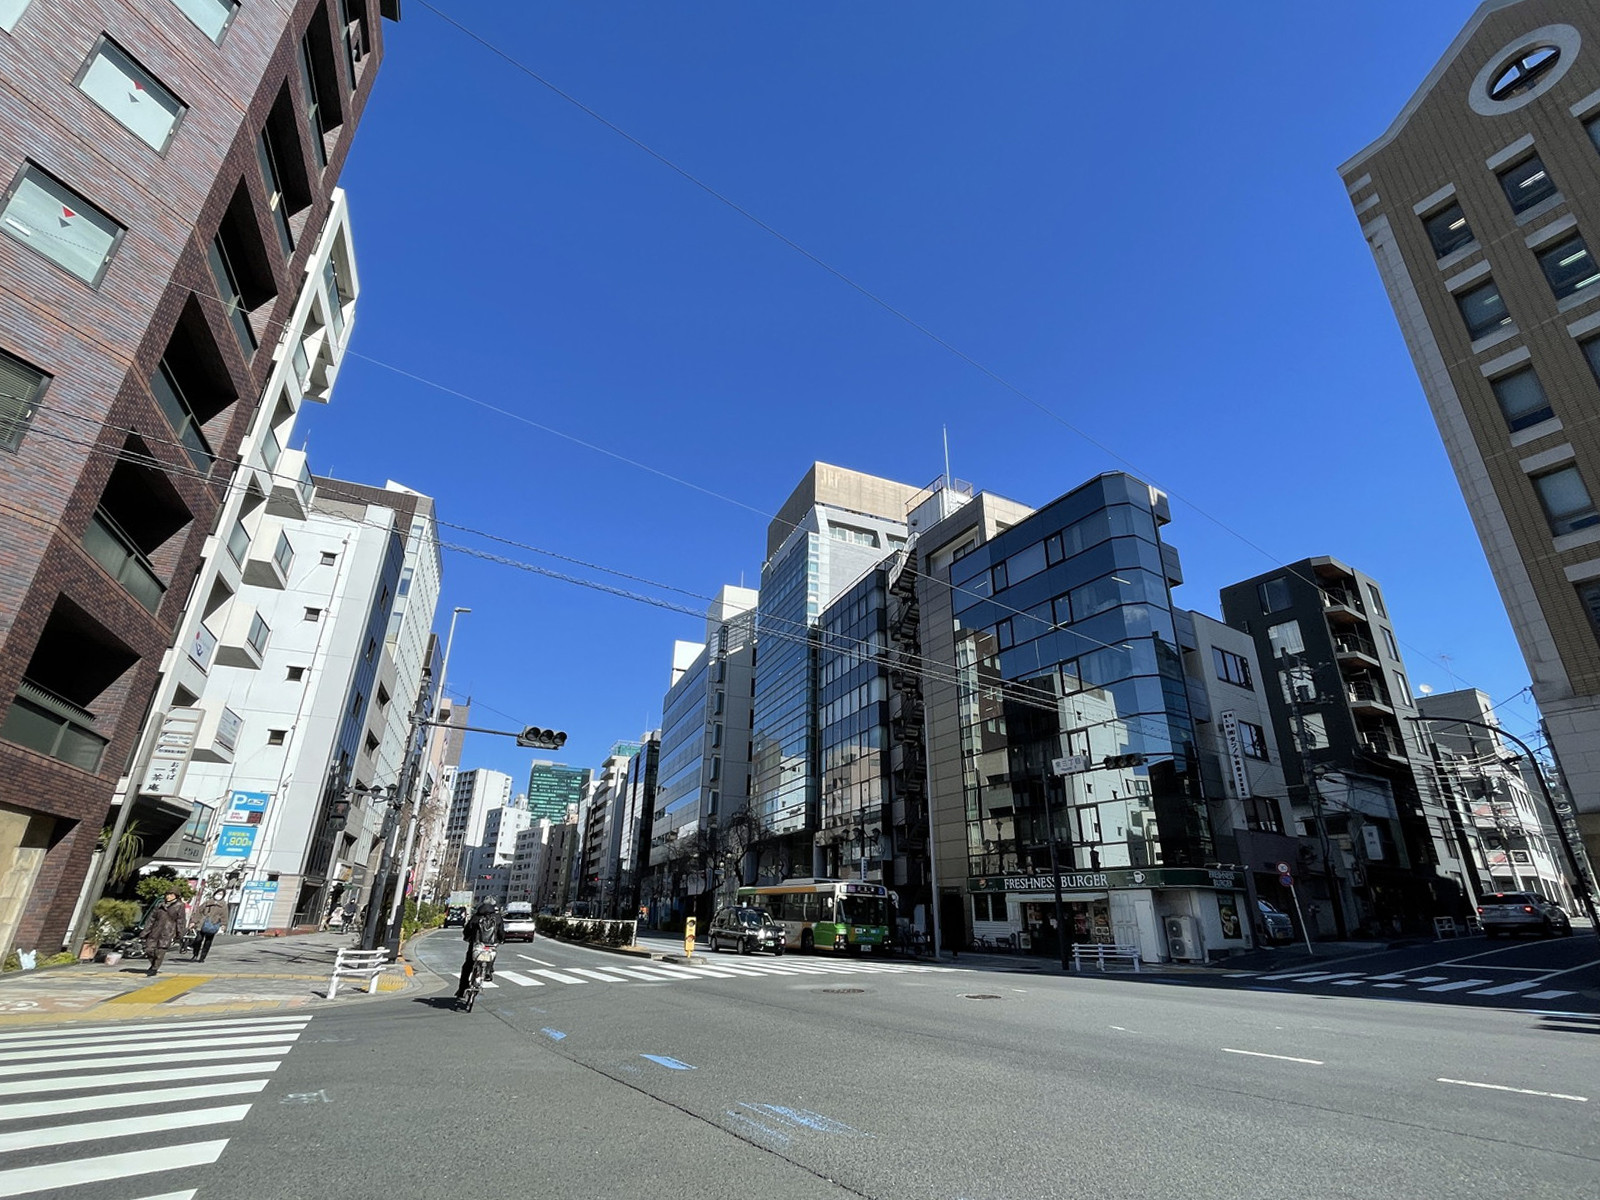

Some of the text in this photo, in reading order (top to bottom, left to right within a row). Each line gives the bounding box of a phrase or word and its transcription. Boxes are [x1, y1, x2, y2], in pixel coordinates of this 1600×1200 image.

[167, 761, 179, 780] おそば
[231, 794, 247, 811] P
[1061, 874, 1108, 888] BURGER
